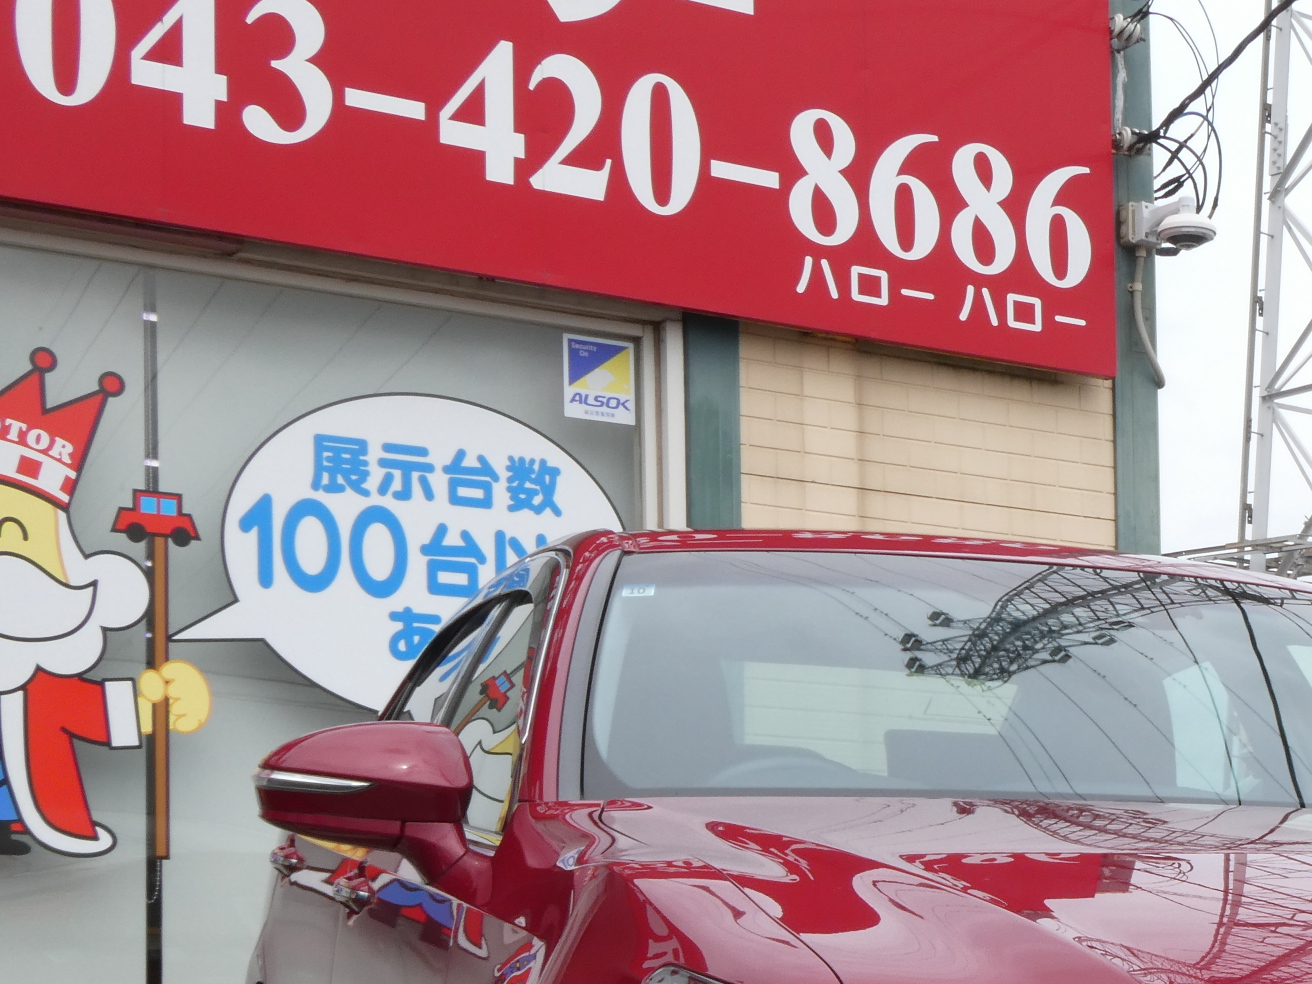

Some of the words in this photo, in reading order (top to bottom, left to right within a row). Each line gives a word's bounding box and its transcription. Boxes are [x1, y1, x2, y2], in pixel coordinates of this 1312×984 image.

[796, 255, 935, 306] ハロー
[959, 284, 1087, 333] ハロー
[569, 392, 632, 412] ALSOK
[0, 418, 74, 464] TOR
[311, 433, 563, 518] 展示台数
